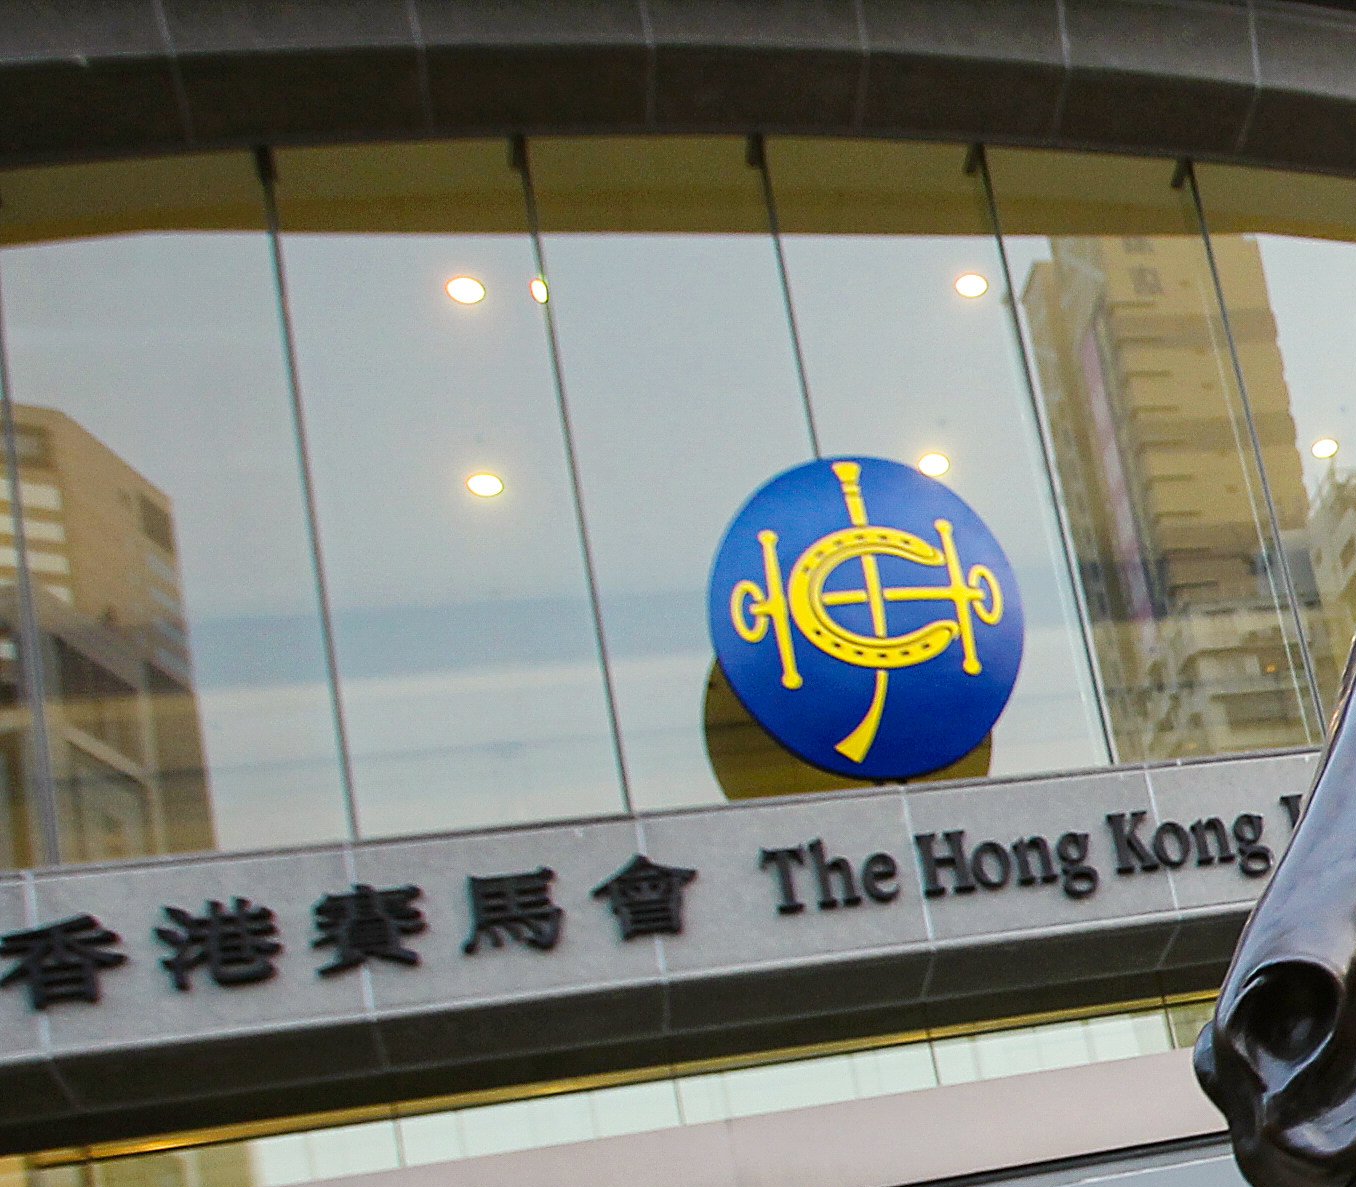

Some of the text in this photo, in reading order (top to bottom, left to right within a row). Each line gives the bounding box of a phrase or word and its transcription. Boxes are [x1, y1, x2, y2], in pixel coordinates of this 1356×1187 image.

[758, 836, 901, 914] The
[914, 830, 1099, 899] Hong
[1105, 810, 1273, 877] Kong
[0, 853, 697, 1010] 香港賽馬會
